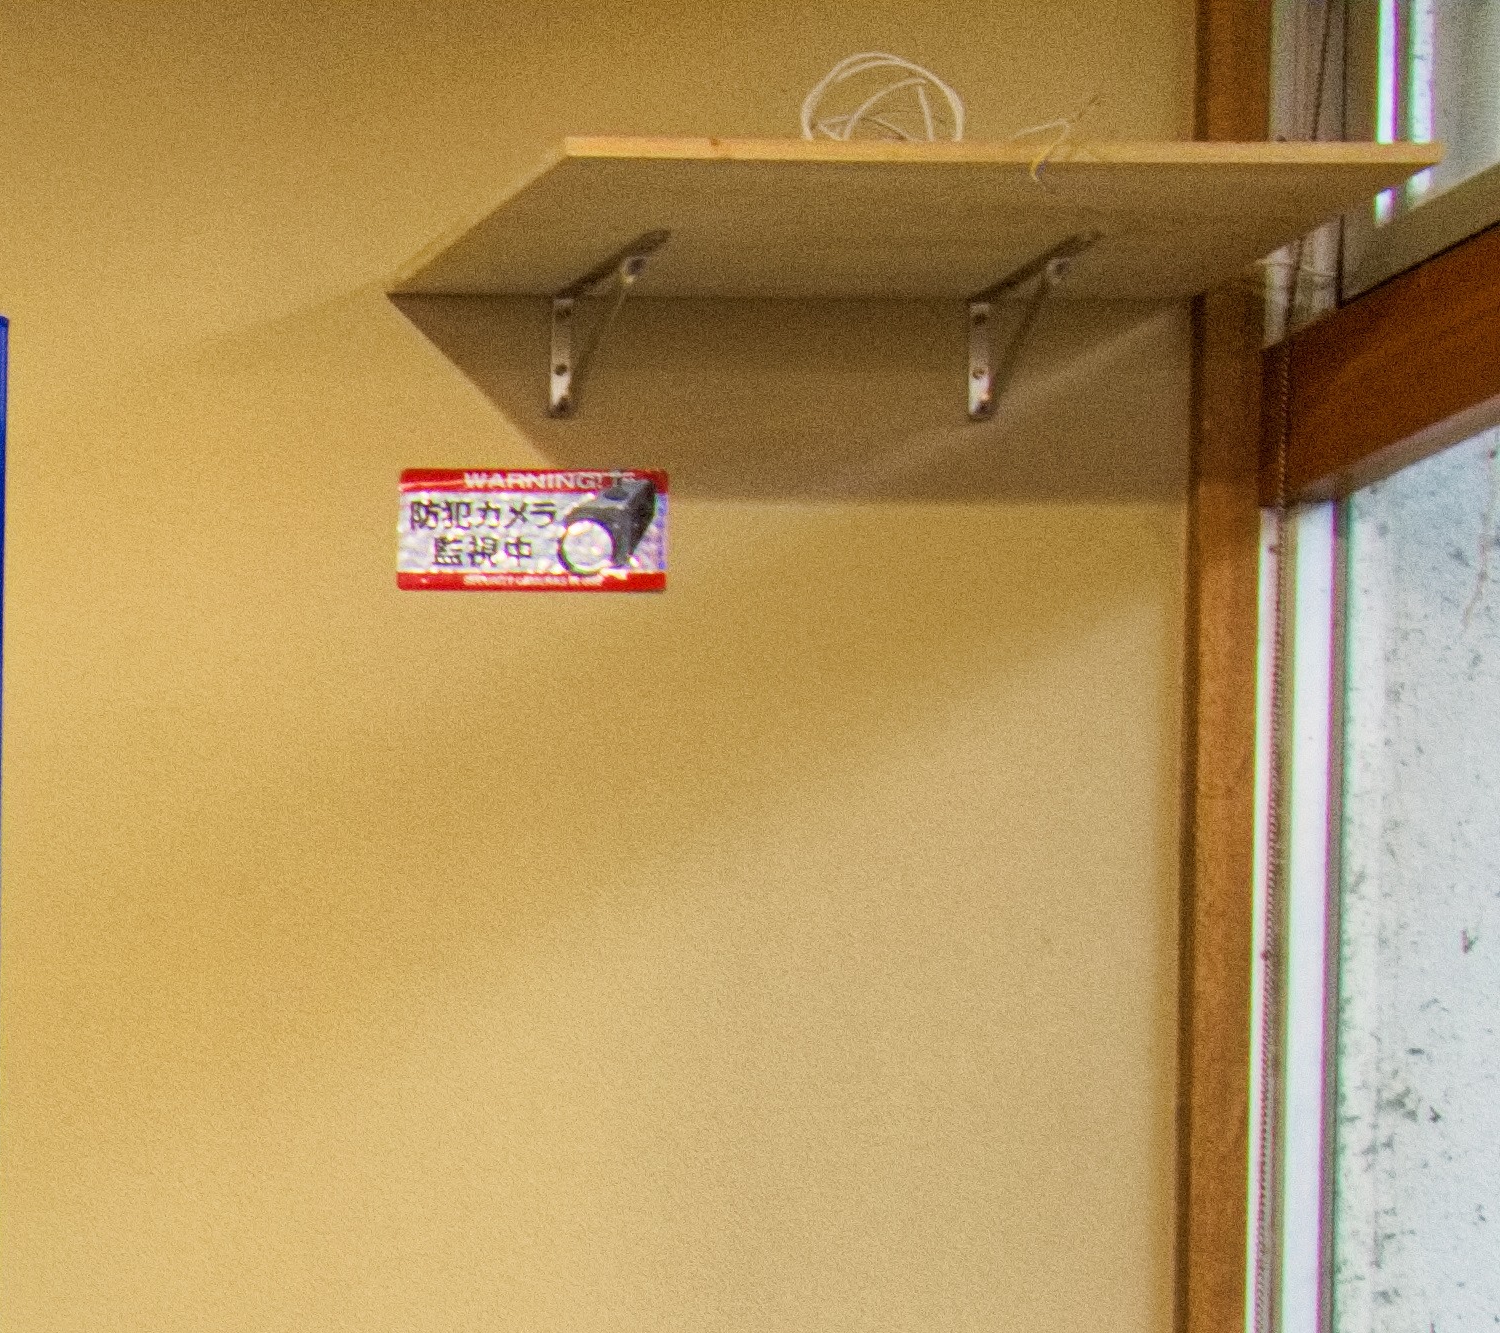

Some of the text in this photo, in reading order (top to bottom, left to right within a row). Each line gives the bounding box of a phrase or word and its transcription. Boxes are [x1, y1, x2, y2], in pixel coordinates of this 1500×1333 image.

[410, 500, 557, 530] 防犯カメラ
[432, 536, 533, 567] 監視中
